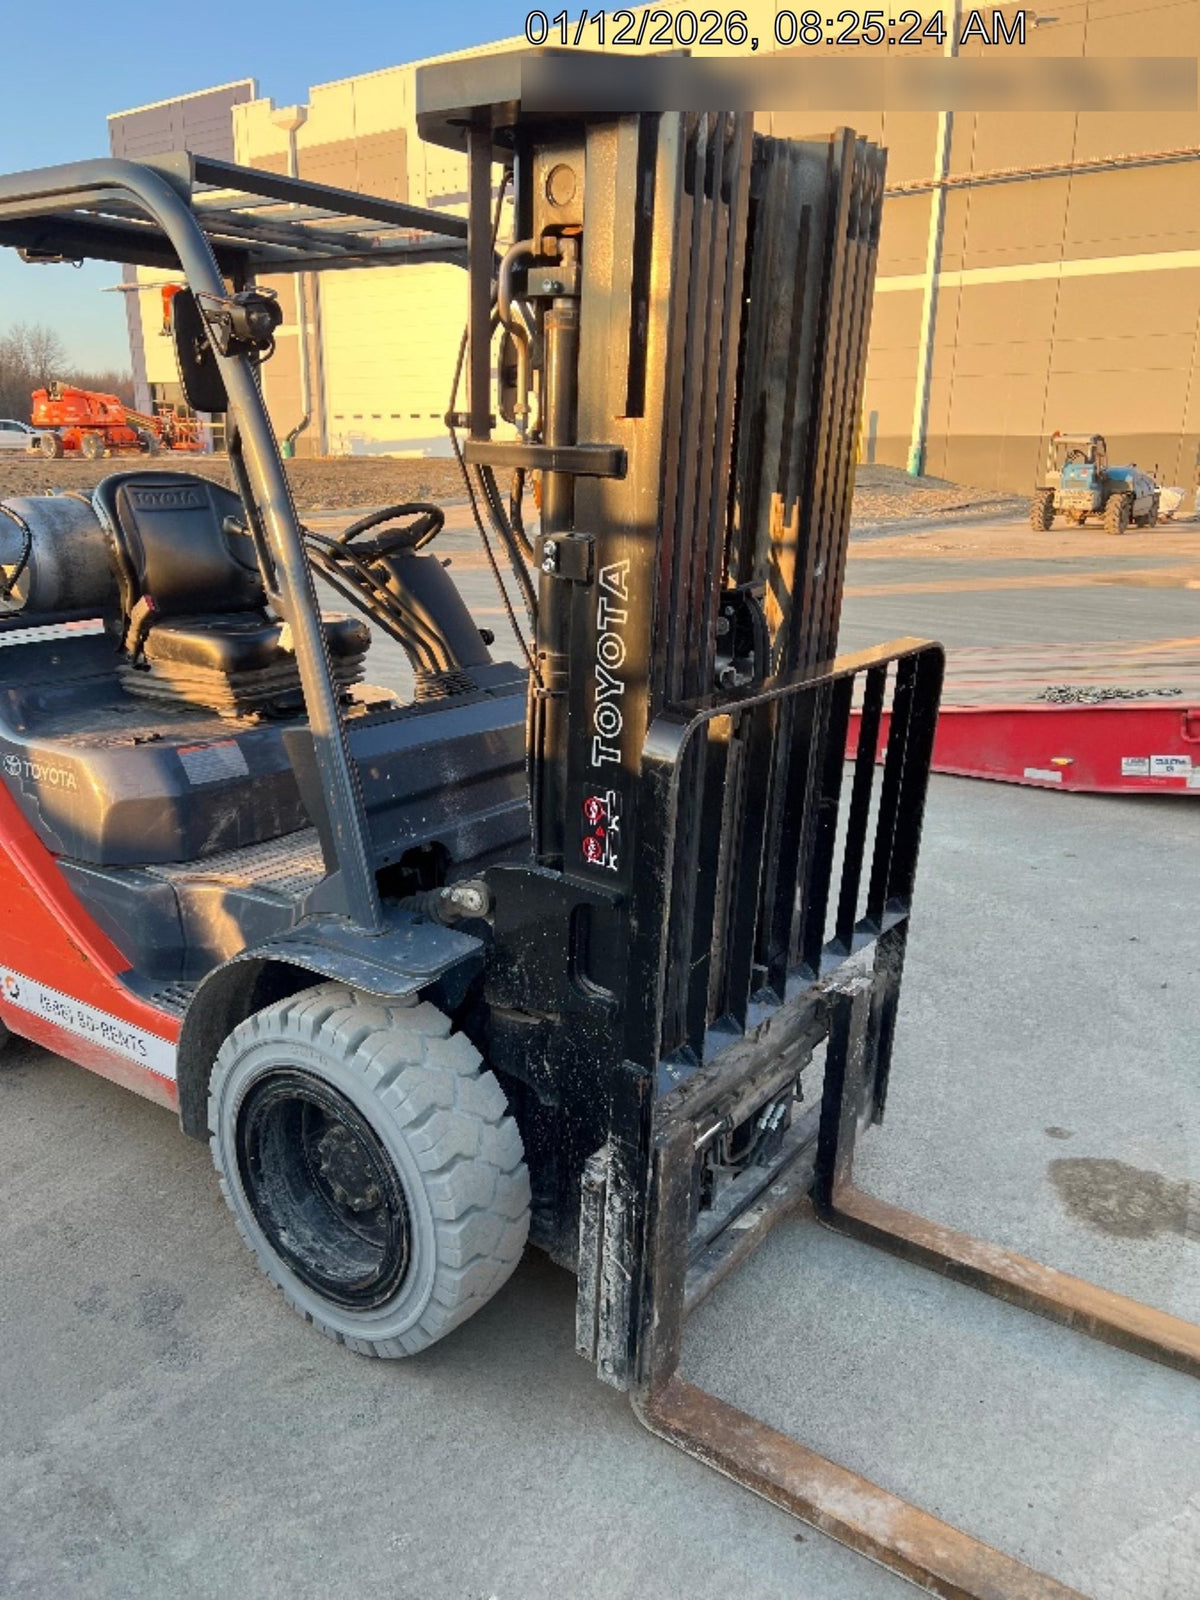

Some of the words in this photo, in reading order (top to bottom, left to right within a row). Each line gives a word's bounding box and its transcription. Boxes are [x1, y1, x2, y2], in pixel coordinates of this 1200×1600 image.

[133, 491, 200, 505] TOYOTA
[592, 558, 631, 767] TOYOTA
[22, 760, 77, 790] TOYOTA
